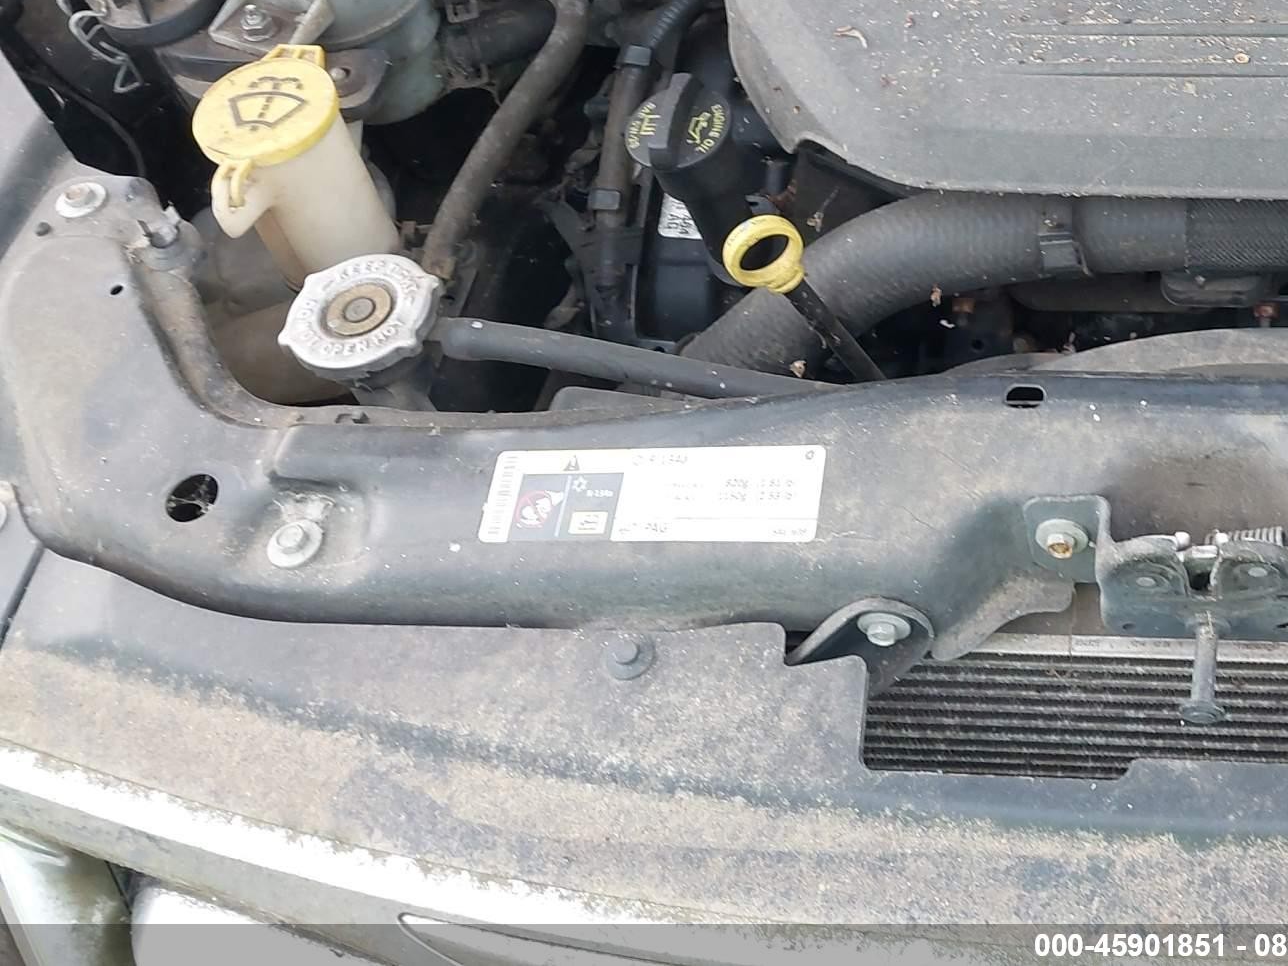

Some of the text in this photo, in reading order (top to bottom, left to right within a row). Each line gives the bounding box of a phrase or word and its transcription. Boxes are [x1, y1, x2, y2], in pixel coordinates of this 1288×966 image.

[694, 103, 726, 155] ENGINE OIL
[321, 339, 370, 356] OPEN
[371, 319, 407, 347] HOT
